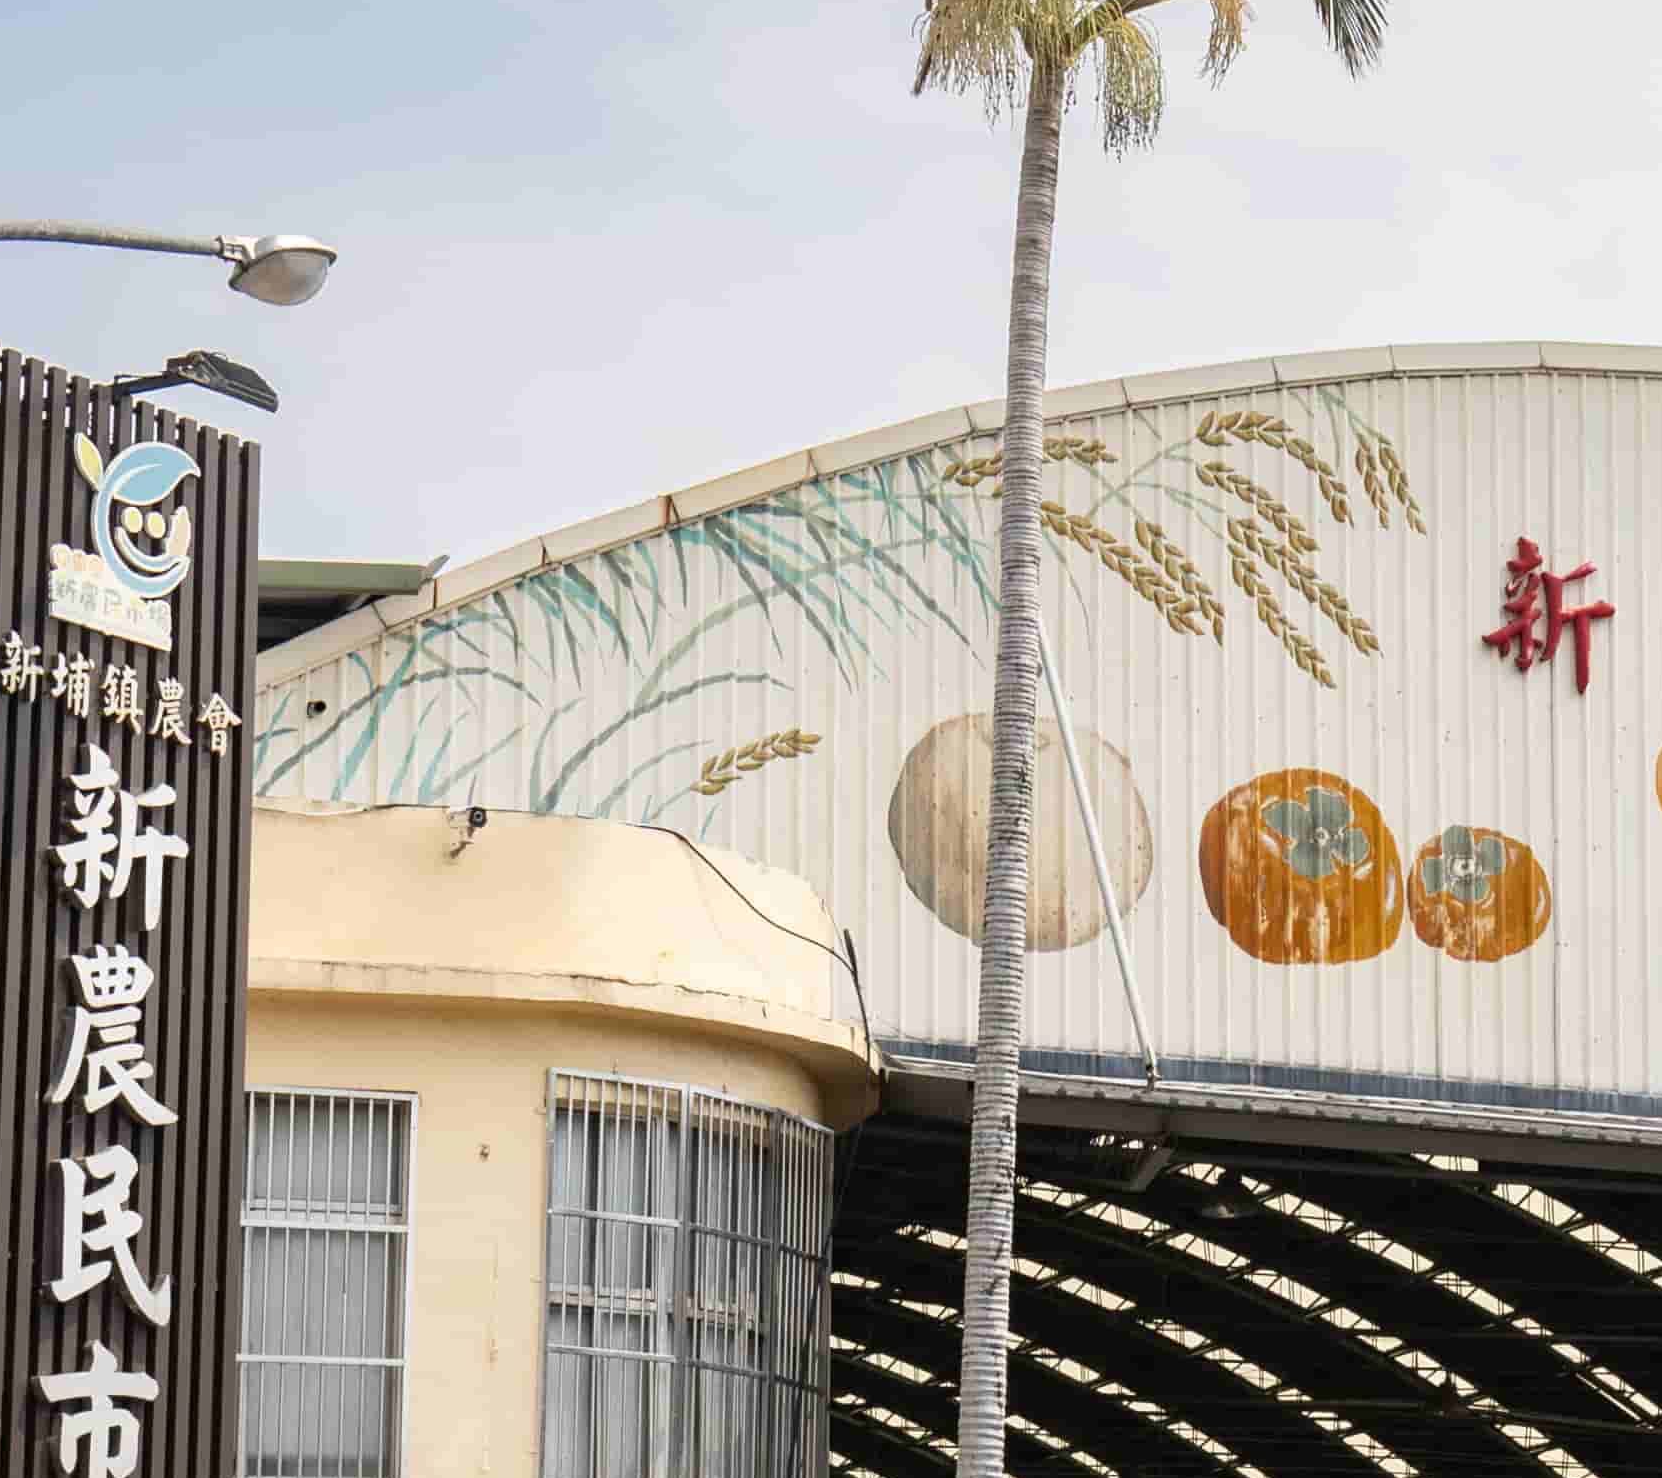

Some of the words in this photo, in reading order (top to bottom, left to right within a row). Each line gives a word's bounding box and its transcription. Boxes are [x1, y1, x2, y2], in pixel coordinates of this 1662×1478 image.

[0, 630, 243, 758] 新埔鎮農會
